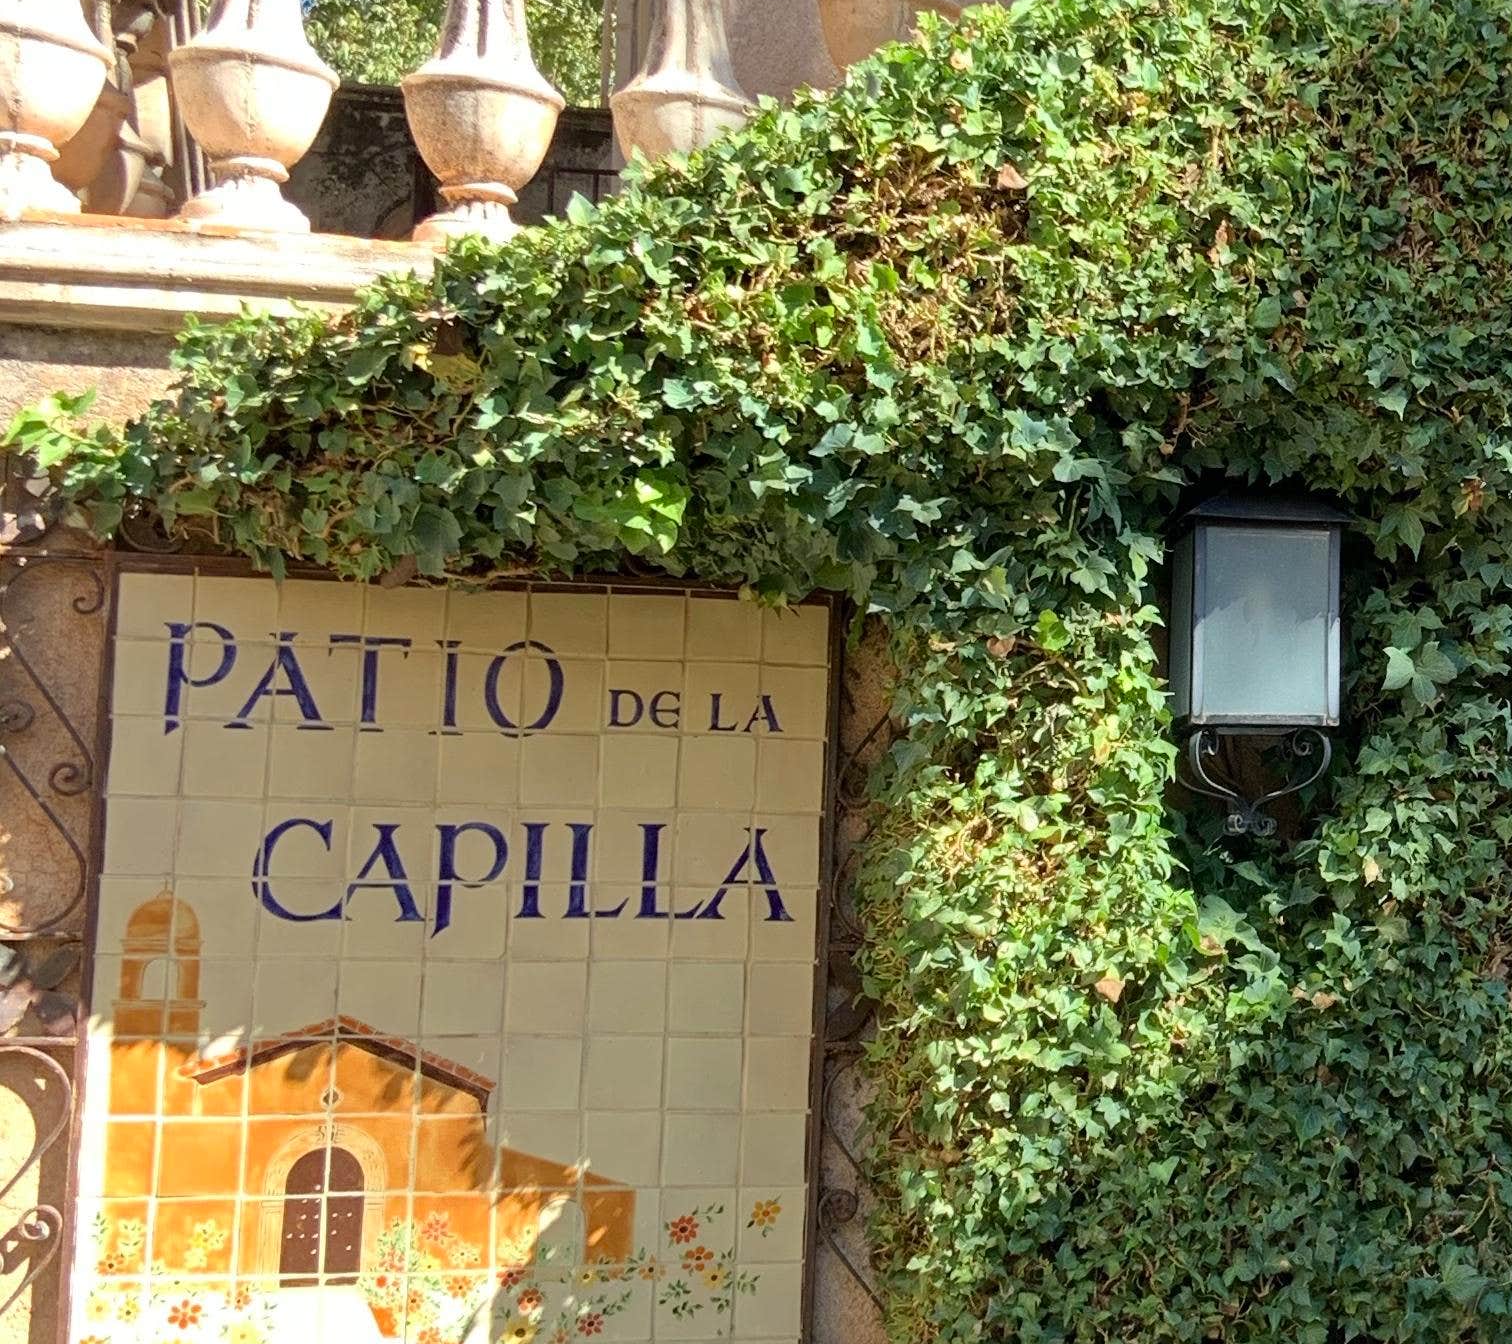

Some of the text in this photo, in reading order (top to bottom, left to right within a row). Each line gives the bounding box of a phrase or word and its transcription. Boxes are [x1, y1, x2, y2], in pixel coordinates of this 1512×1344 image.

[164, 622, 784, 738] PATIO DE LA
[252, 817, 796, 939] CAPILLA
